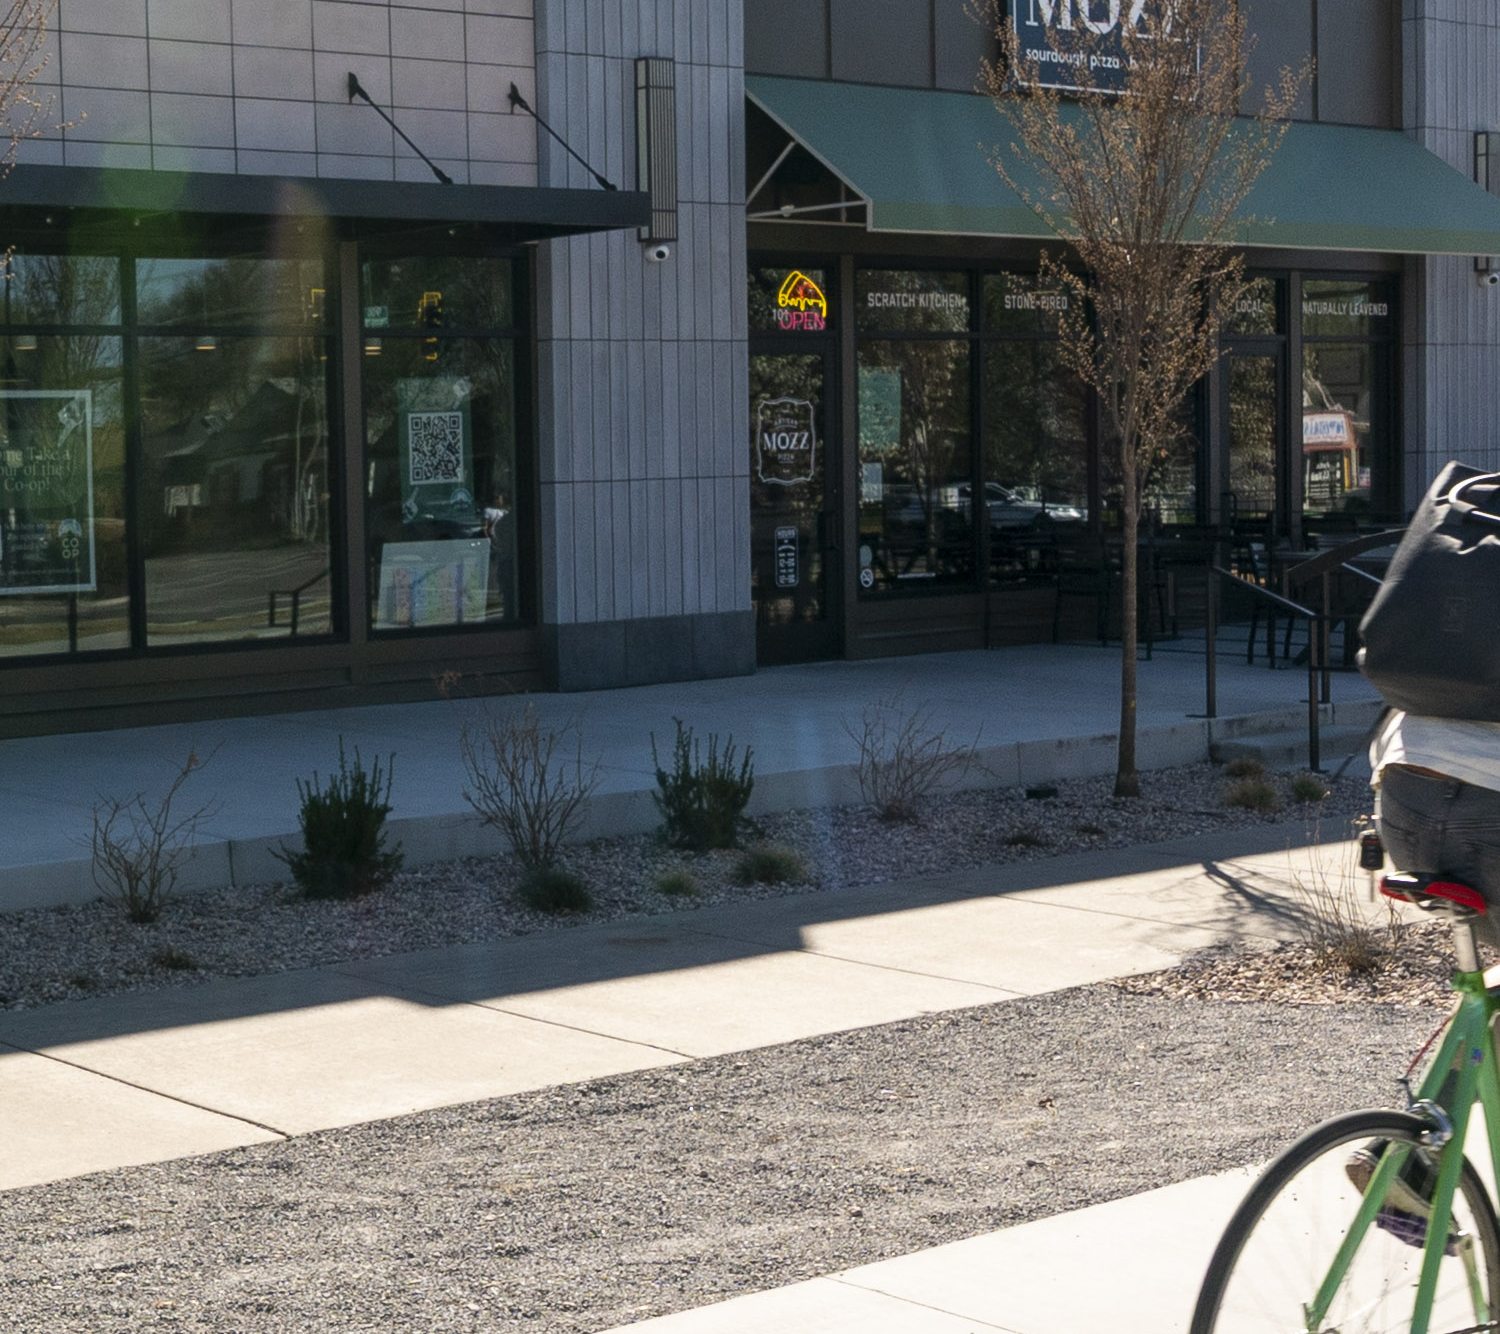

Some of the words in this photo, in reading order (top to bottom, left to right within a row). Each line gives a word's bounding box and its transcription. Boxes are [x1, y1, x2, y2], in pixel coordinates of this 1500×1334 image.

[1026, 48, 1087, 67] sourdough
[1090, 52, 1120, 70] pizza
[867, 292, 916, 308] SCRATCH
[918, 292, 962, 308] KITCHEN
[1235, 299, 1263, 313] LOCAL
[1302, 301, 1347, 316] NATURALLY
[1349, 302, 1388, 316] LEAVENED
[779, 311, 826, 330] OPEN
[763, 432, 809, 451] MOZZ
[27, 445, 58, 461] Take
[24, 462, 38, 476] of
[41, 460, 63, 476] the
[4, 477, 50, 495] Co-op!
